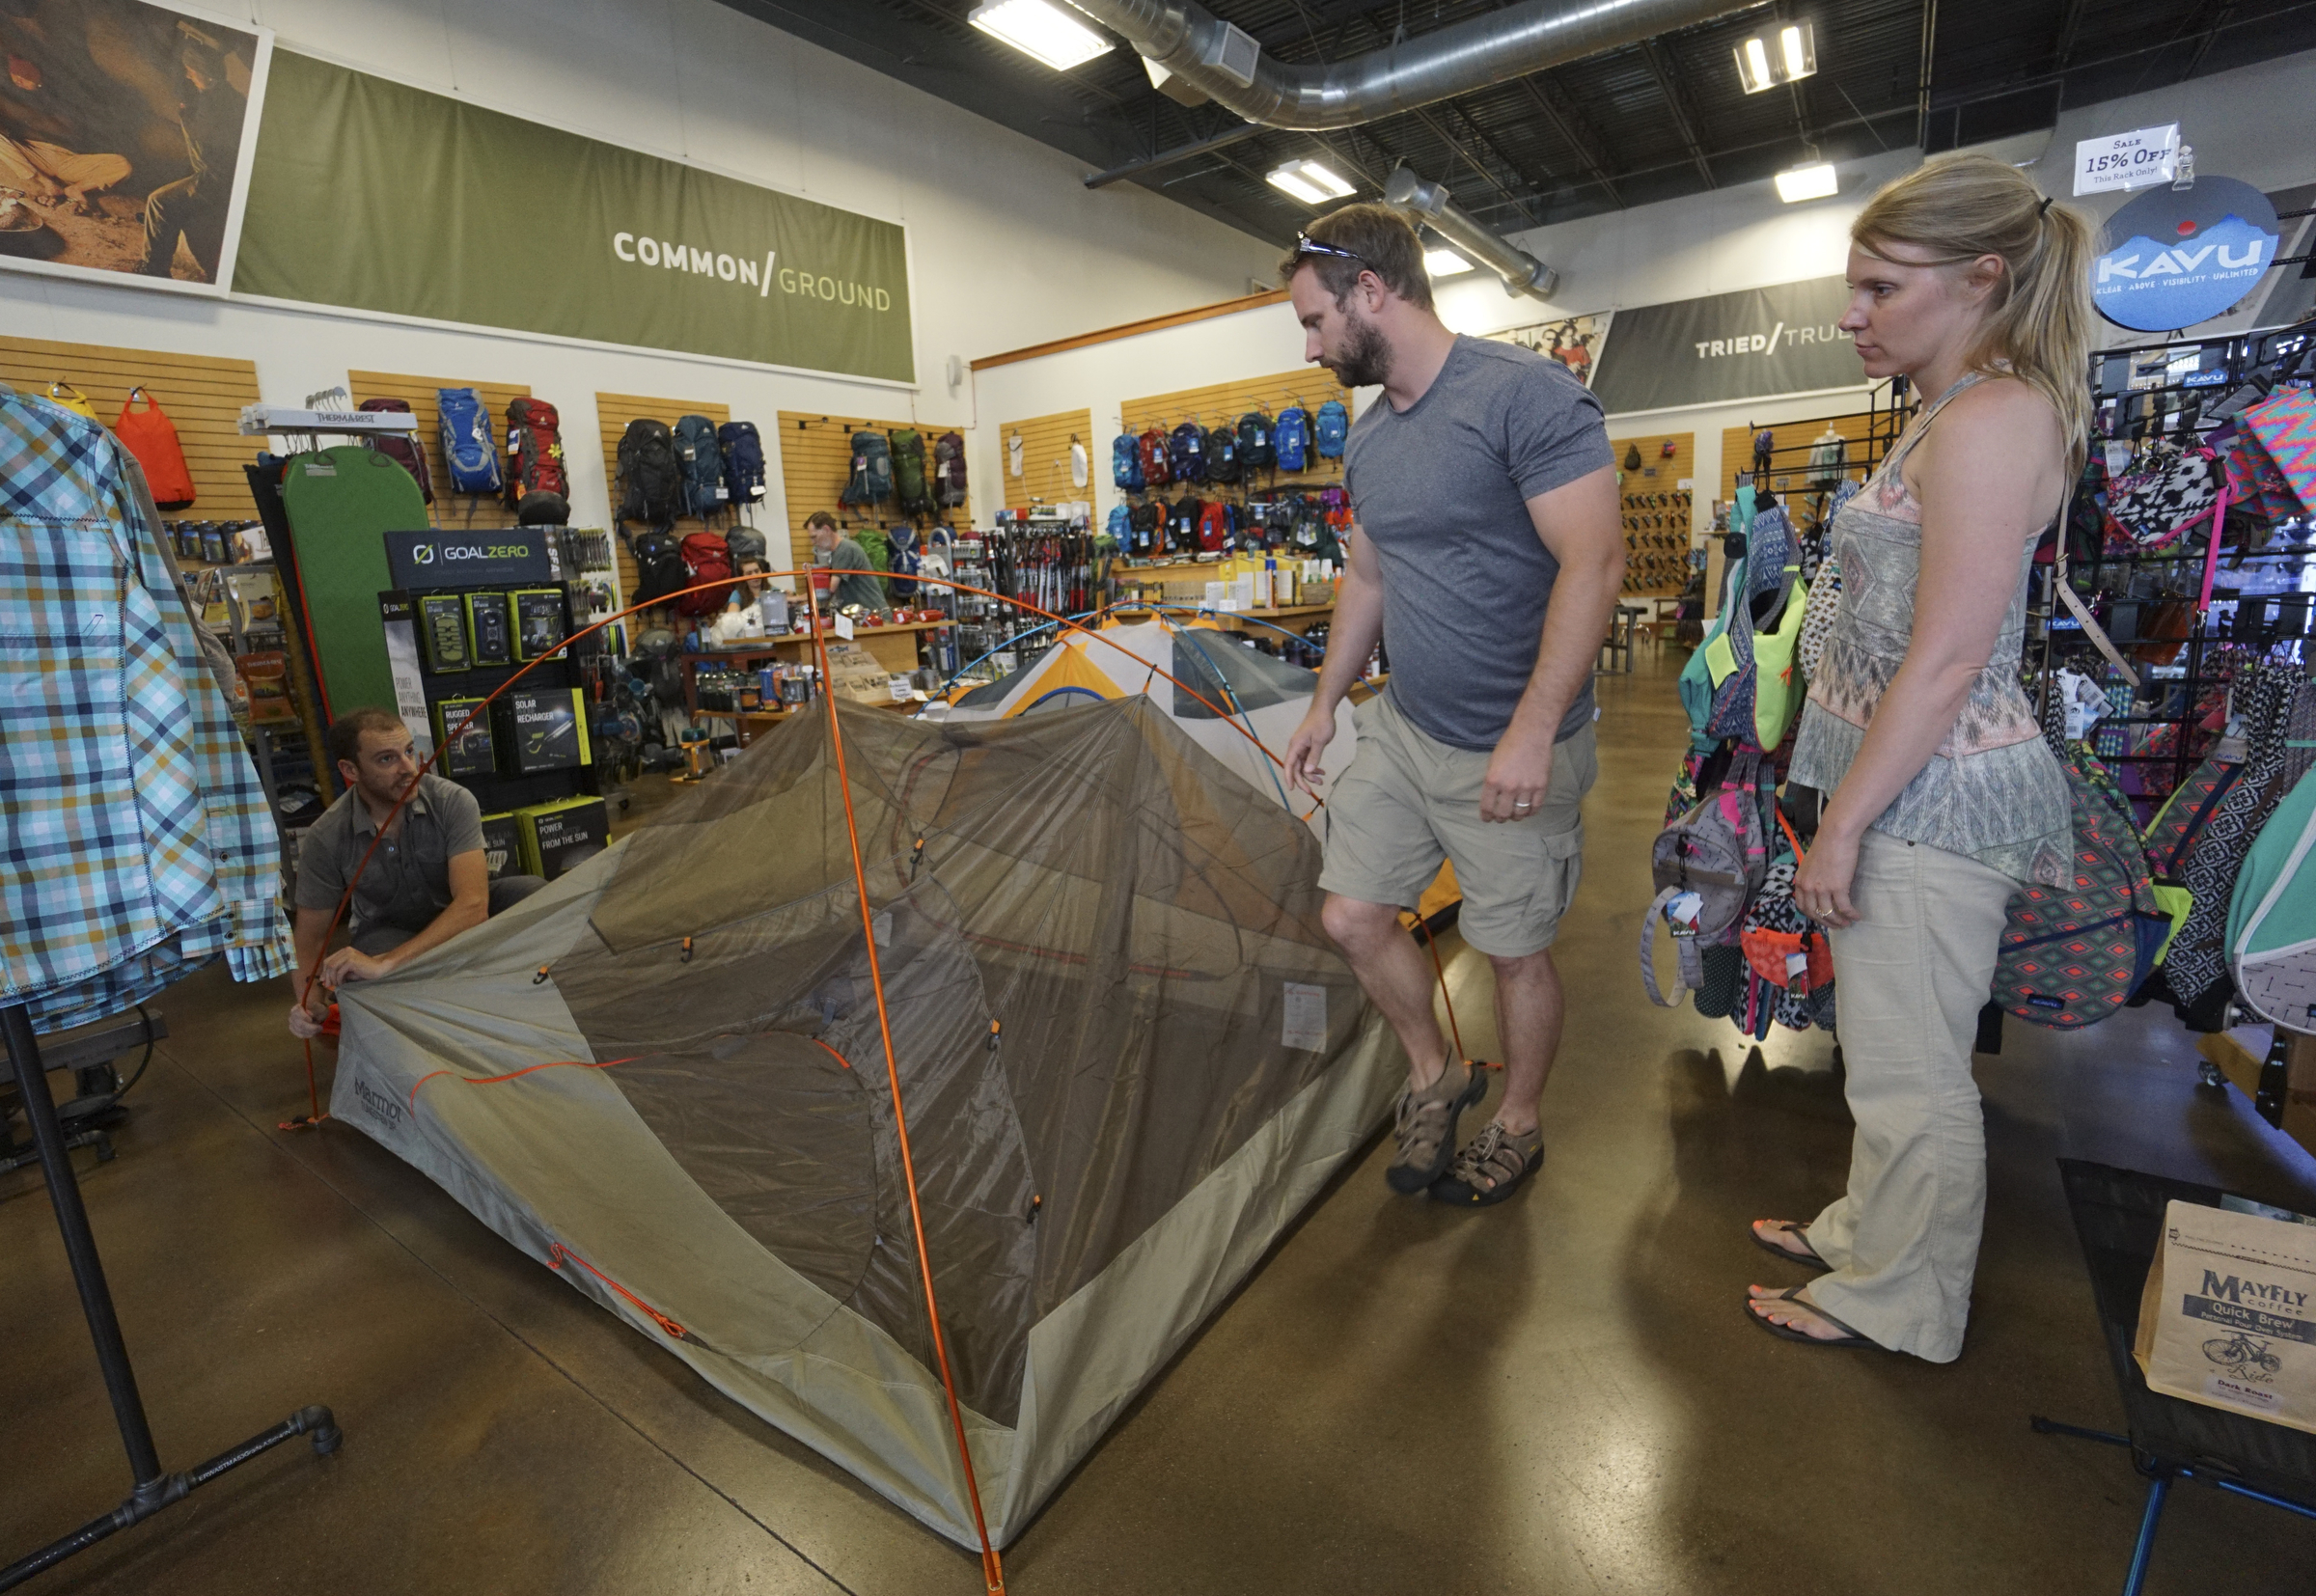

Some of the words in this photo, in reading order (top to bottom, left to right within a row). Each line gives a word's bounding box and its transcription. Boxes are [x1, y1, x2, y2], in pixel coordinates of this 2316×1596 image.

[2085, 151, 2129, 174] 15%
[2093, 174, 2112, 184] This
[2113, 170, 2135, 181] Rack
[2136, 166, 2158, 179] Only!
[2098, 240, 2263, 284] KAVU
[2129, 280, 2156, 291] ABOVE
[2163, 274, 2206, 287] VISIBILITY
[2213, 267, 2259, 281] UNLIMITED
[2187, 374, 2223, 383] KAVU
[445, 545, 529, 560] GOALZERO
[396, 677, 412, 689] POWER
[399, 692, 421, 704] ANYTHING
[515, 700, 537, 709] SOLAR
[400, 705, 427, 718] ANYWHERE
[445, 709, 470, 719] RUGGED
[517, 712, 555, 724] RECHARGER
[539, 822, 564, 835] POWER
[541, 838, 562, 850] FROM
[562, 835, 574, 845] THE
[574, 831, 589, 842] SUN
[2247, 1299, 2303, 1315] coffee
[2213, 1303, 2250, 1320] Quick
[2258, 1314, 2294, 1329] Brew
[2200, 1311, 2232, 1325] Personal
[2234, 1320, 2252, 1330] Pour
[2254, 1325, 2274, 1335] Over
[2276, 1330, 2303, 1340] System
[2227, 1364, 2274, 1384] Ride
[2218, 1379, 2241, 1390] Dark
[2245, 1387, 2274, 1400] Roast
